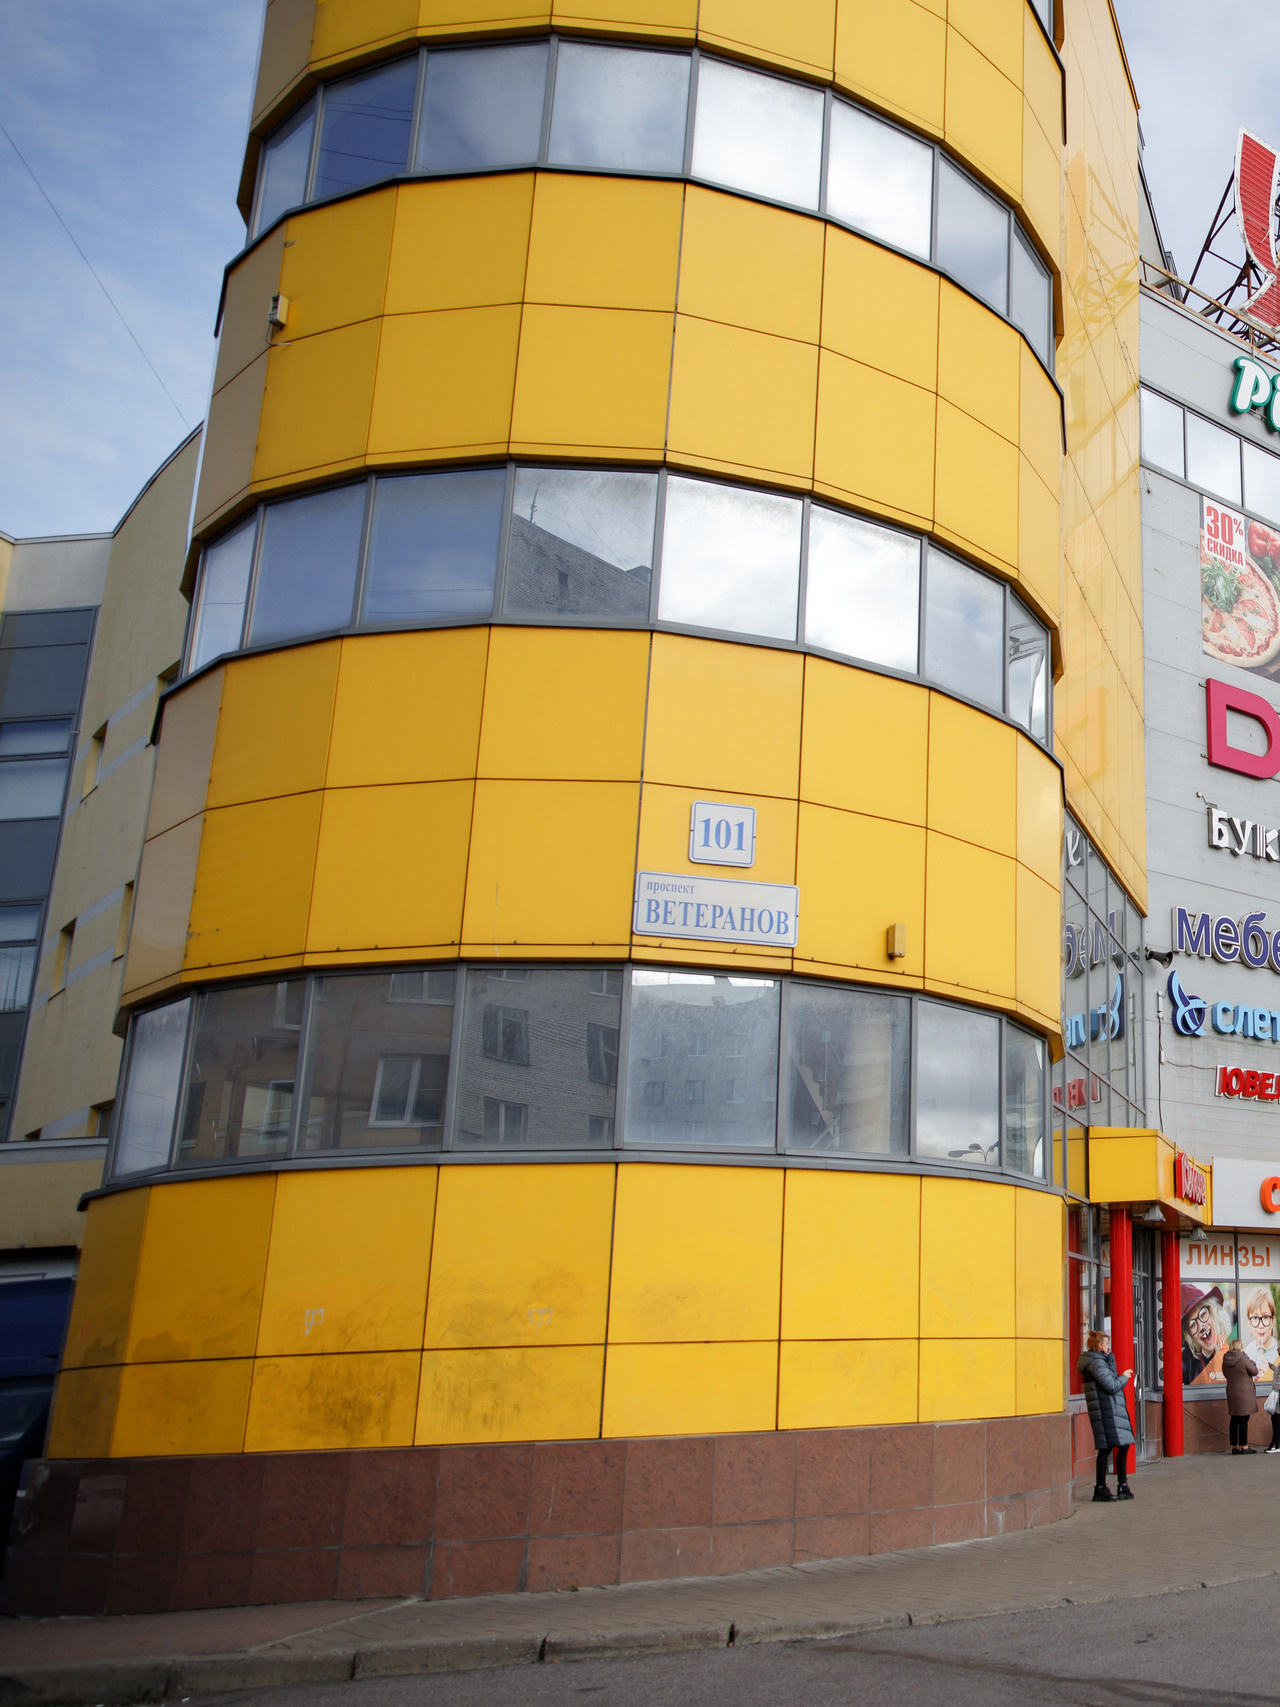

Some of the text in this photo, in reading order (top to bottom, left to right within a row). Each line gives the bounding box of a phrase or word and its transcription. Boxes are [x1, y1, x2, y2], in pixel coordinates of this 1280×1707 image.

[1206, 506, 1244, 546] 30%
[1207, 538, 1244, 567] СКИДКА
[699, 817, 747, 852] 101
[646, 879, 696, 895] проспект
[645, 897, 790, 936] ВЕТЕРАНОВ
[1185, 1243, 1271, 1268] ЛИНЗЫ
